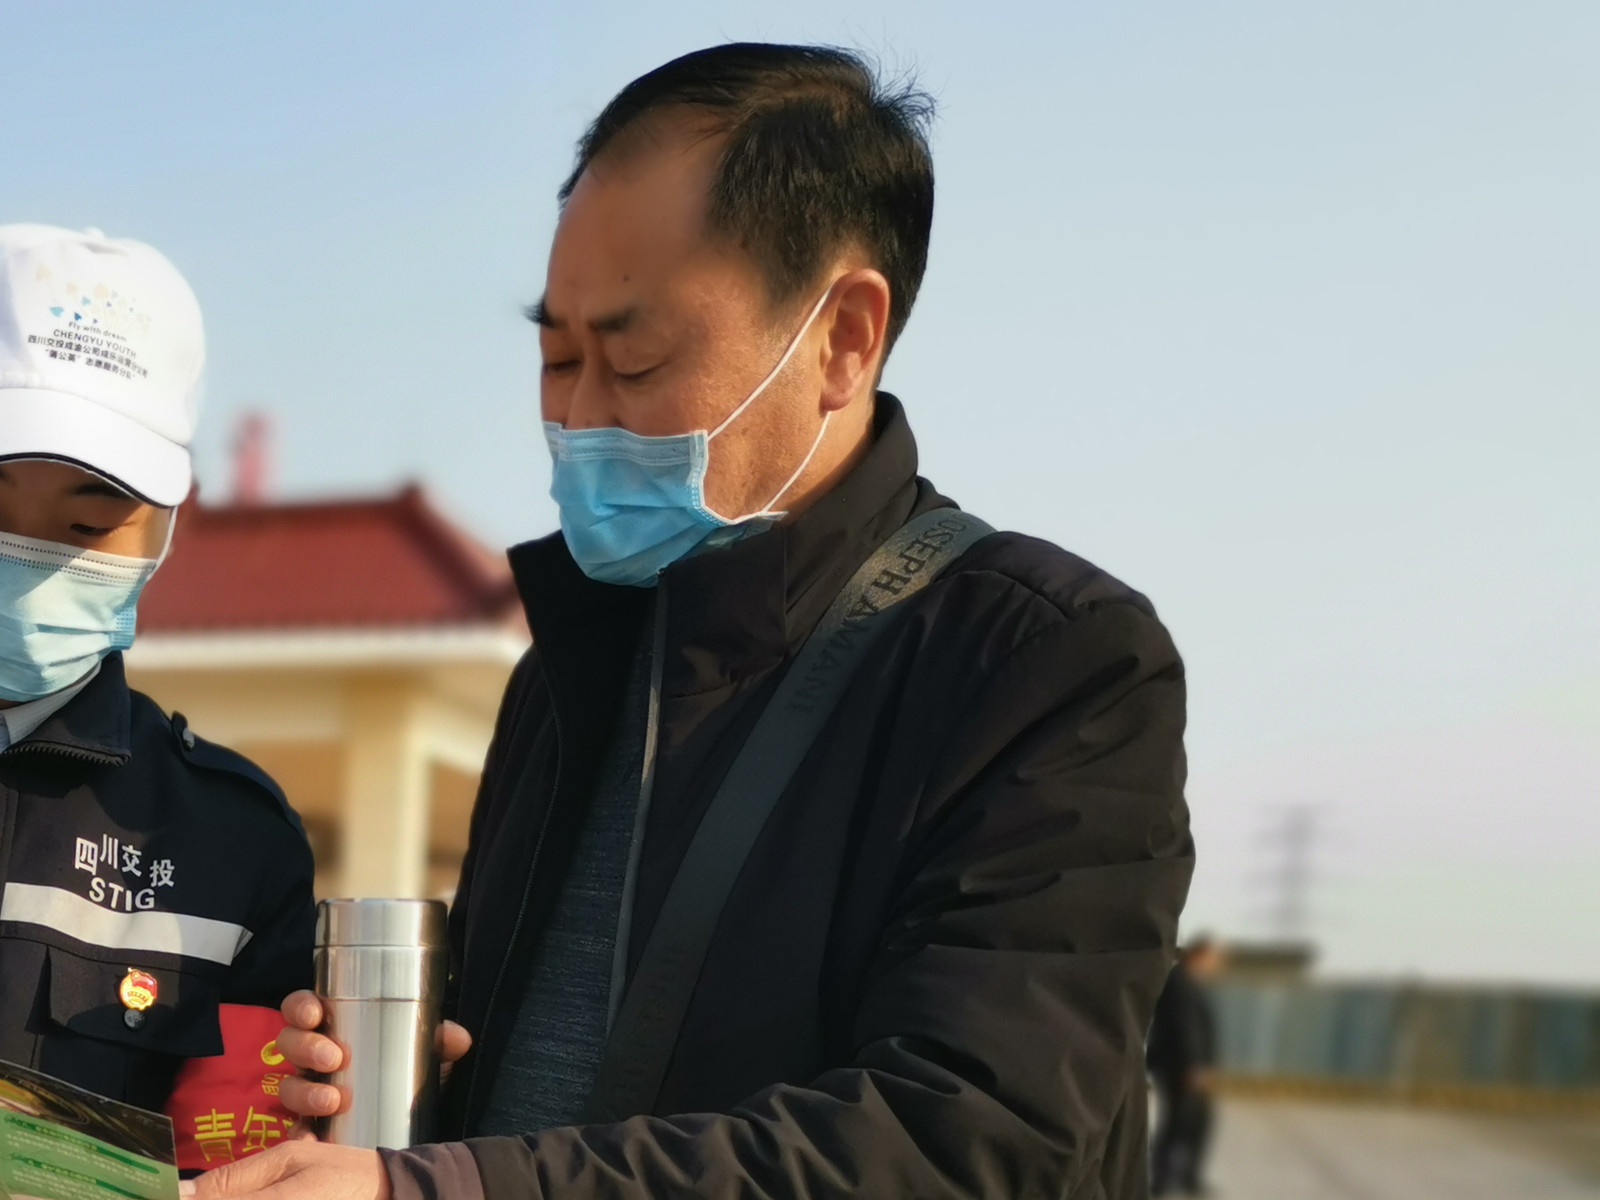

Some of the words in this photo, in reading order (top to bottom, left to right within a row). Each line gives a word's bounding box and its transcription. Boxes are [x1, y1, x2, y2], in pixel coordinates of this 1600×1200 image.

[53, 328, 104, 347] CHENGYU
[105, 340, 137, 359] YOUTH
[83, 324, 102, 335] with
[74, 833, 175, 888] 四川交投
[89, 877, 155, 912] STIG
